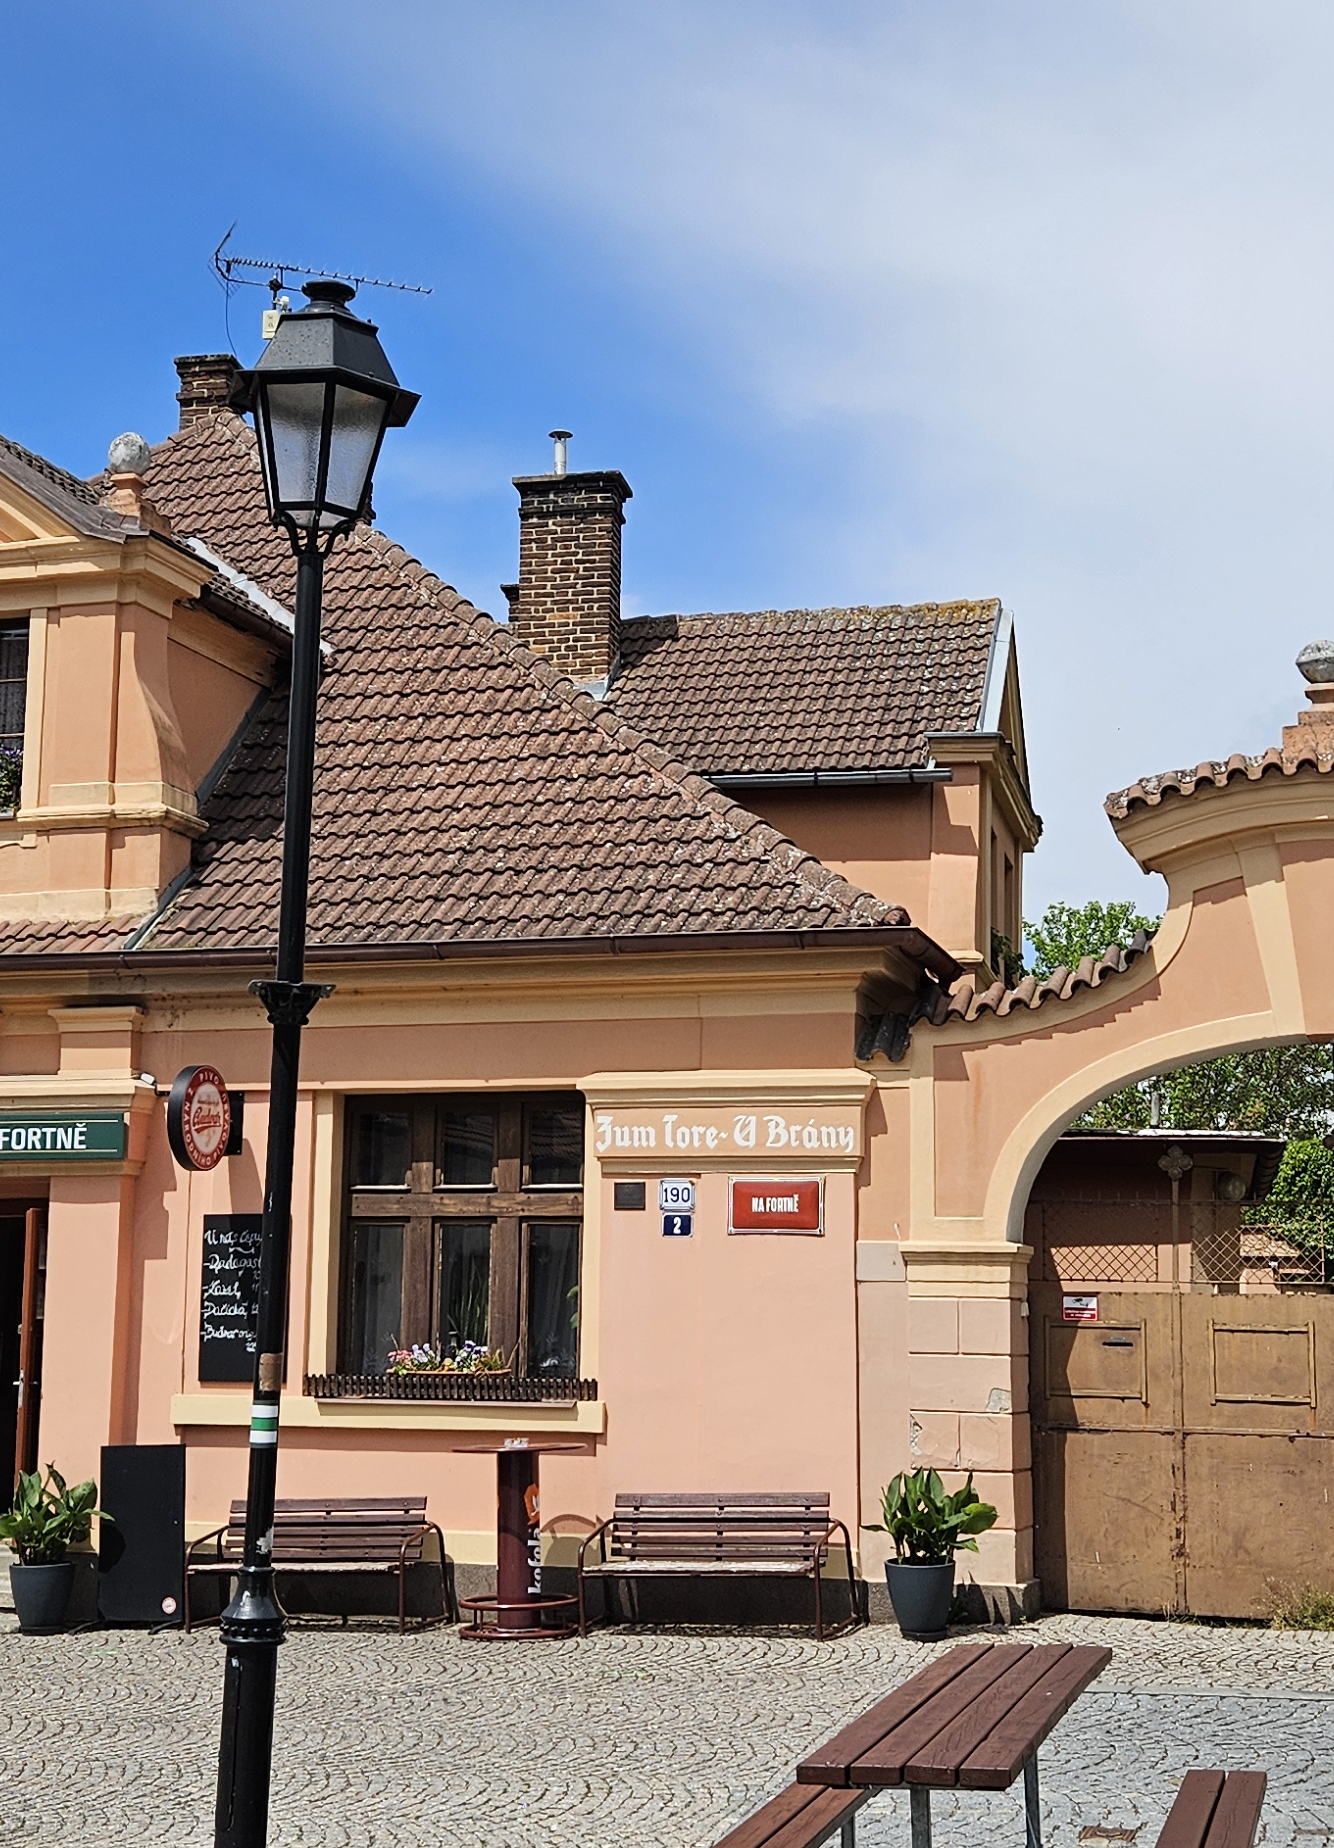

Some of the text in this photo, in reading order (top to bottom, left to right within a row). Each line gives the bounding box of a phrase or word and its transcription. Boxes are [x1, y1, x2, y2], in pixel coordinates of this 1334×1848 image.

[199, 1071, 219, 1085] PIVO
[596, 1115, 656, 1152] Zum
[763, 1115, 855, 1153] Brány
[663, 1187, 691, 1203] 190
[752, 1193, 799, 1213] NA FORTNĚ
[673, 1216, 682, 1234] 2
